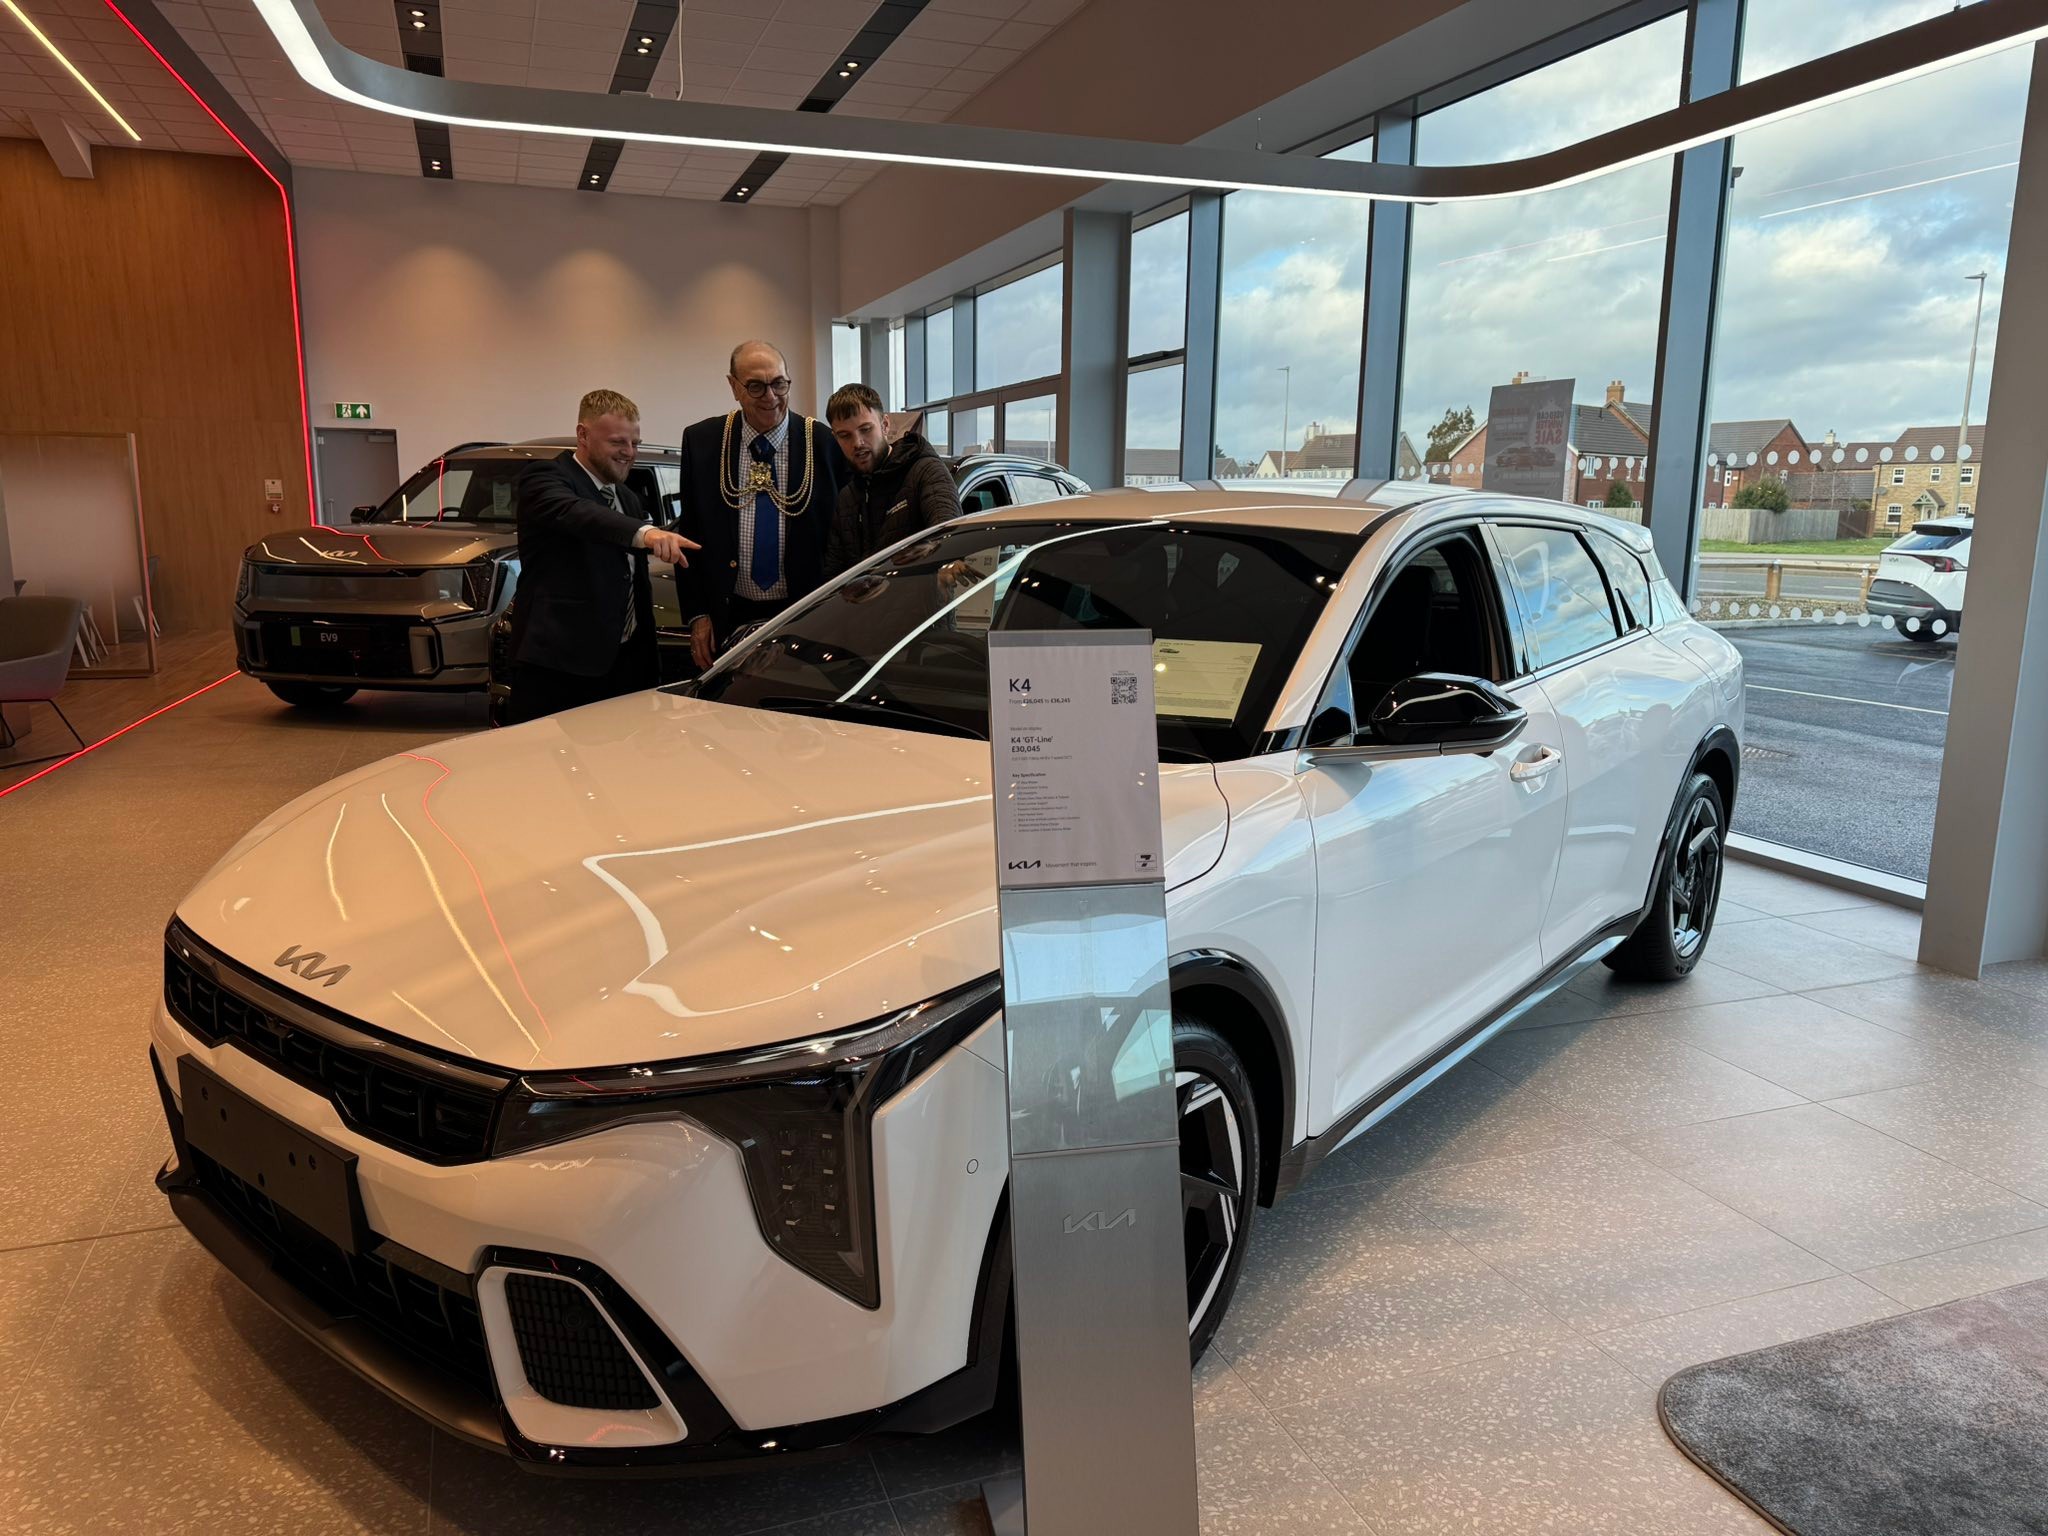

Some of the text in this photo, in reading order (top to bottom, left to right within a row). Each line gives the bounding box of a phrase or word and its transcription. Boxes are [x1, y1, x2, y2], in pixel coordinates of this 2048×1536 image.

[320, 632, 338, 643] EV9
[1009, 678, 1031, 692] K4
[1011, 736, 1021, 744] K4
[1011, 745, 1041, 753] £30,045
[1008, 859, 1041, 870] KIA
[273, 944, 352, 987] KIA
[1063, 1208, 1136, 1234] KIA
